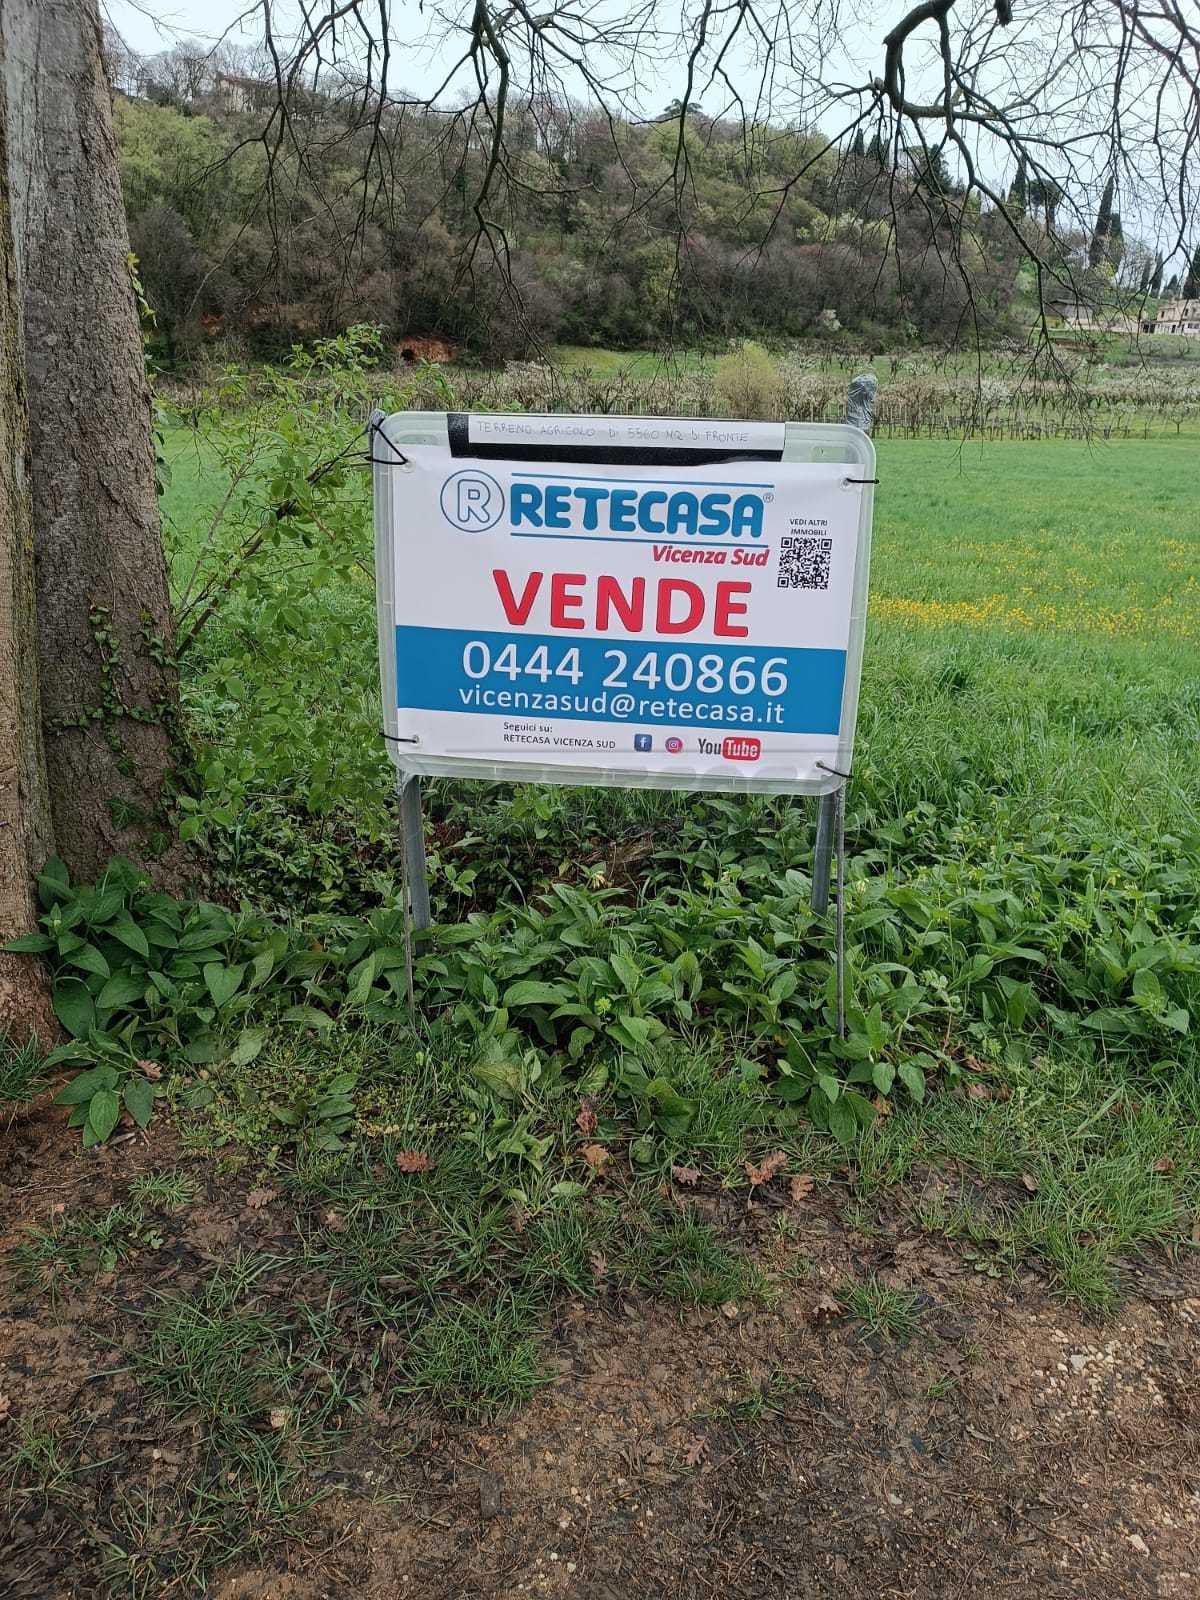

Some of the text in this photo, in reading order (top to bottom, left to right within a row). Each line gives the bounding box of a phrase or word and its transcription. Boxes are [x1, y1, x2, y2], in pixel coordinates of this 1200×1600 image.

[477, 420, 532, 434] TERRENO
[540, 423, 596, 437] AGRICOLO
[789, 518, 807, 526] VEDI
[790, 528, 827, 536] IMMOBILI
[652, 545, 770, 567] Vicenza Sud
[492, 569, 752, 637] VENDE
[462, 640, 788, 697] 0444 240866
[459, 684, 785, 725] vicenzasud@retecasa.it
[503, 721, 553, 733] Seguici su:
[503, 734, 616, 749] RETECASA VICENZA SUD
[698, 738, 759, 758] YouTube
